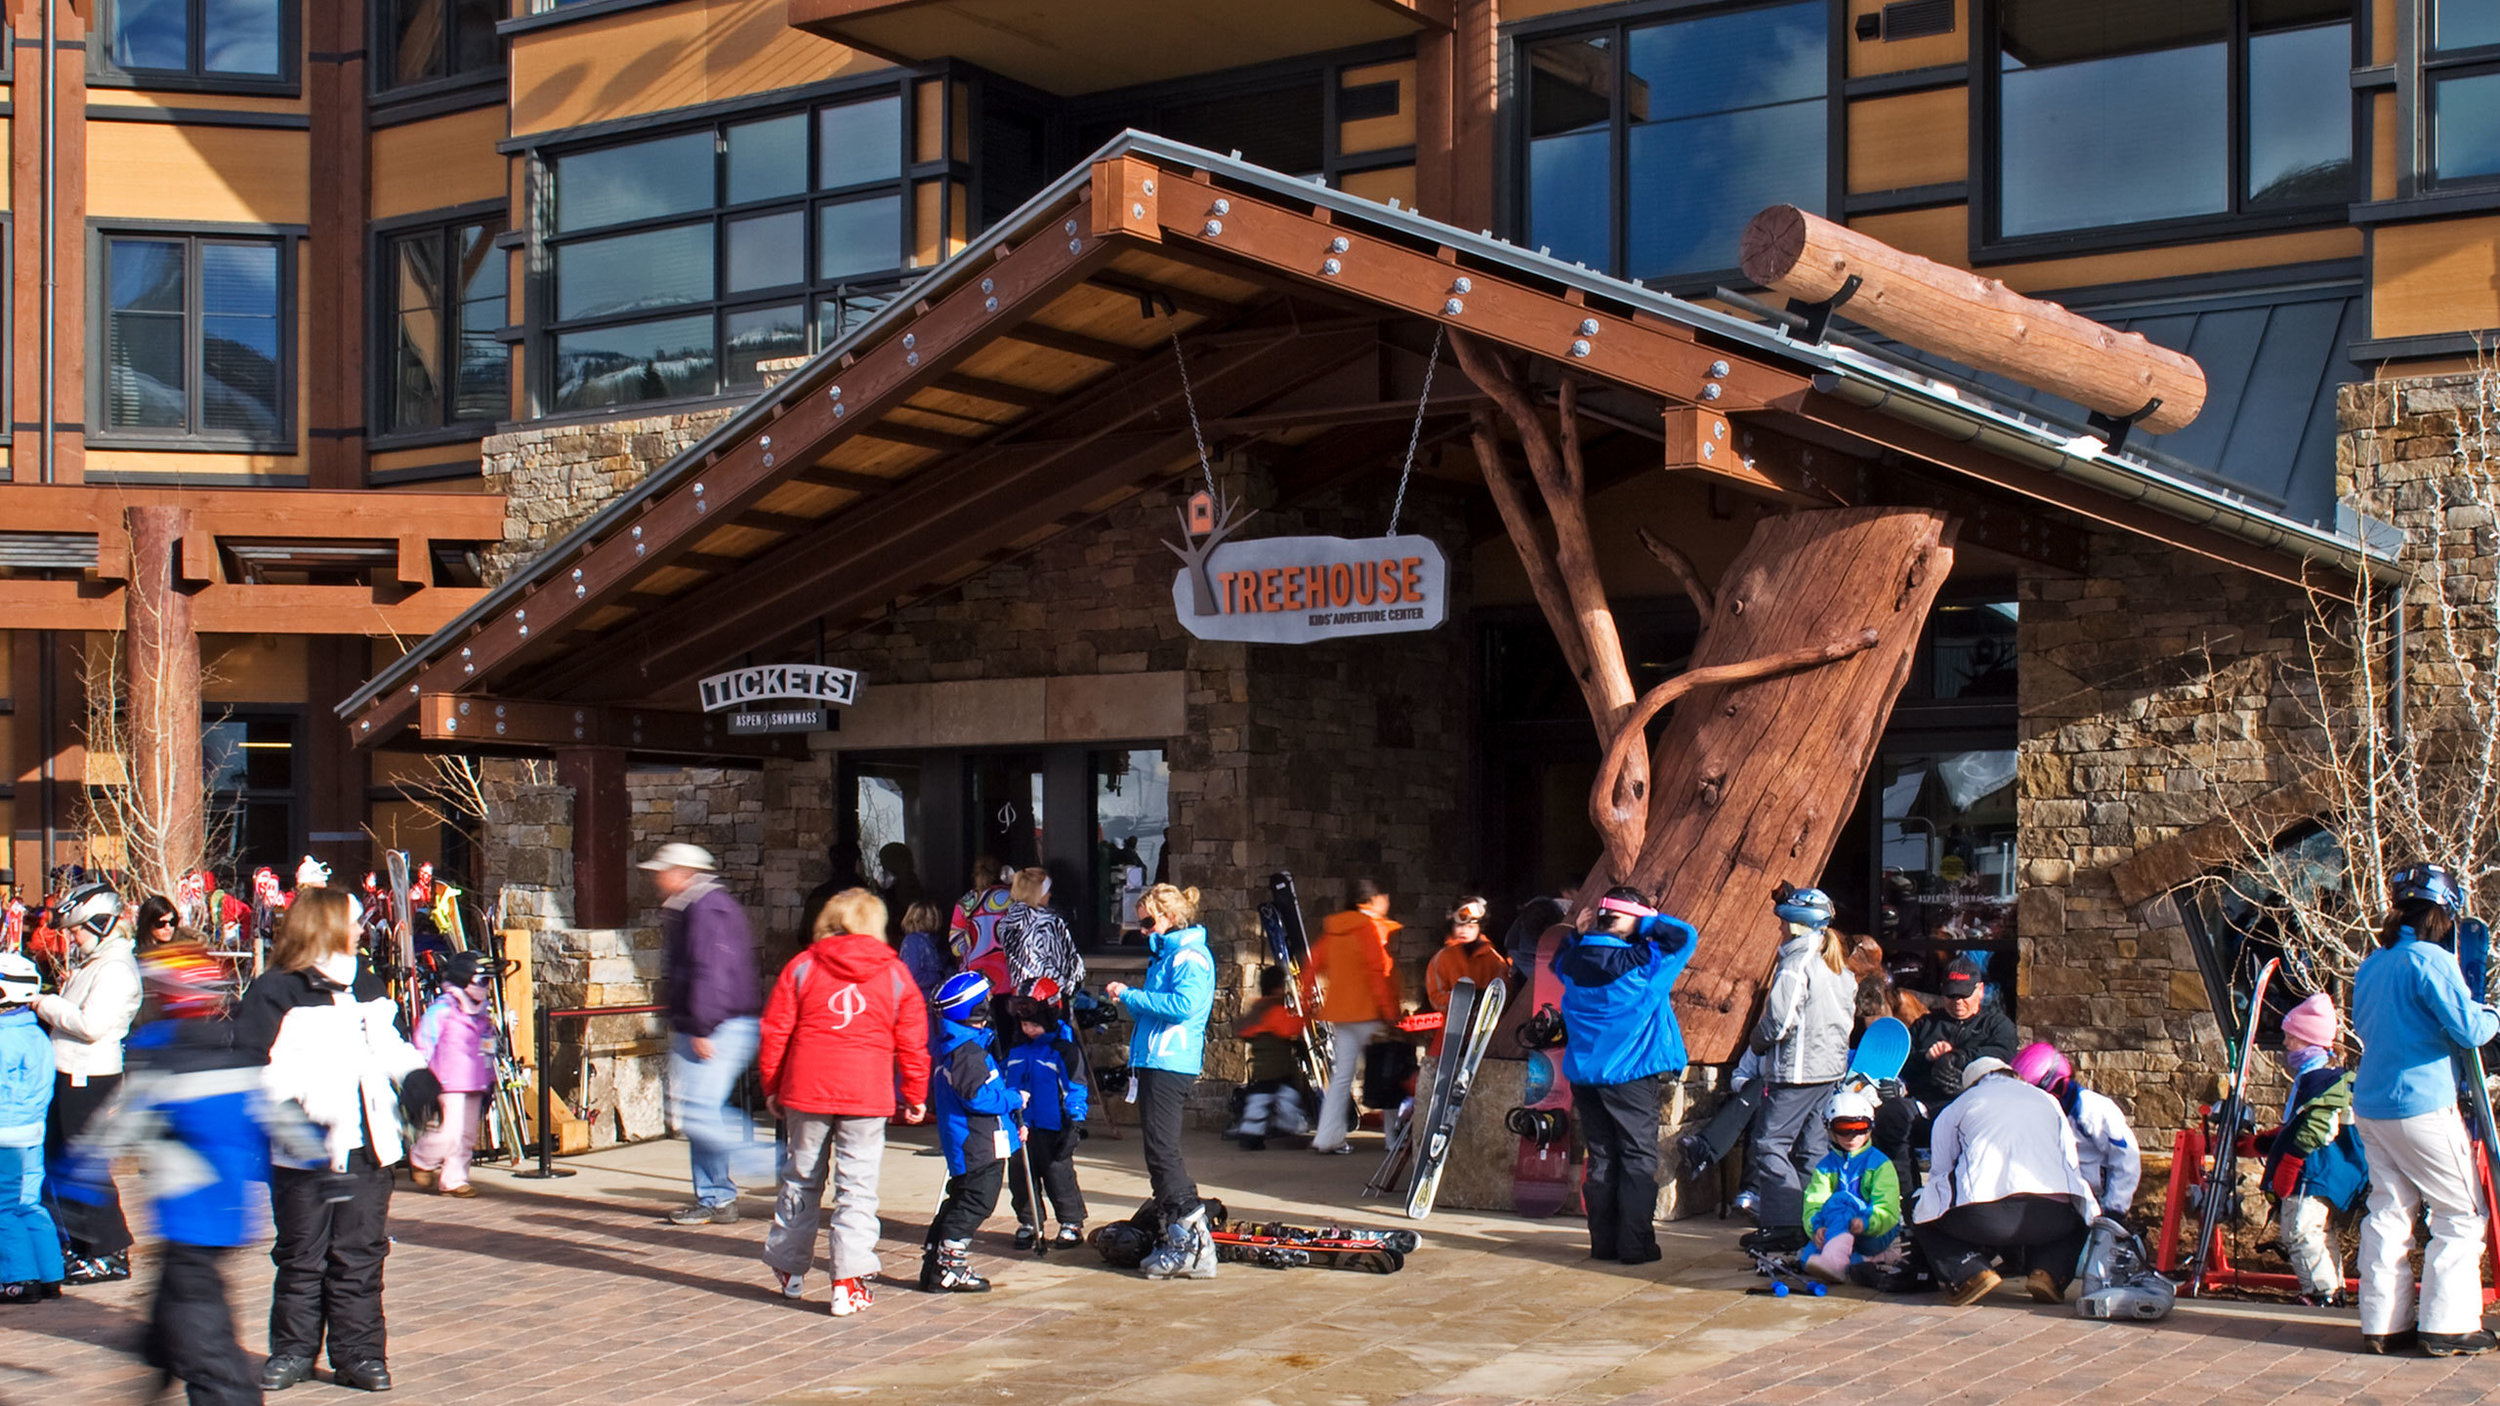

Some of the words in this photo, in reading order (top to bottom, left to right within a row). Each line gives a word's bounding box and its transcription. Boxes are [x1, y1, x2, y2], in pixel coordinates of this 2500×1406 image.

[1217, 557, 1422, 615] TREEHOUSE
[1333, 610, 1387, 625] ADVENTURE
[1388, 607, 1424, 621] CENTER
[706, 668, 847, 706] TICKETS
[736, 715, 762, 727] ASPEN
[771, 712, 817, 725] SNOWMASS
